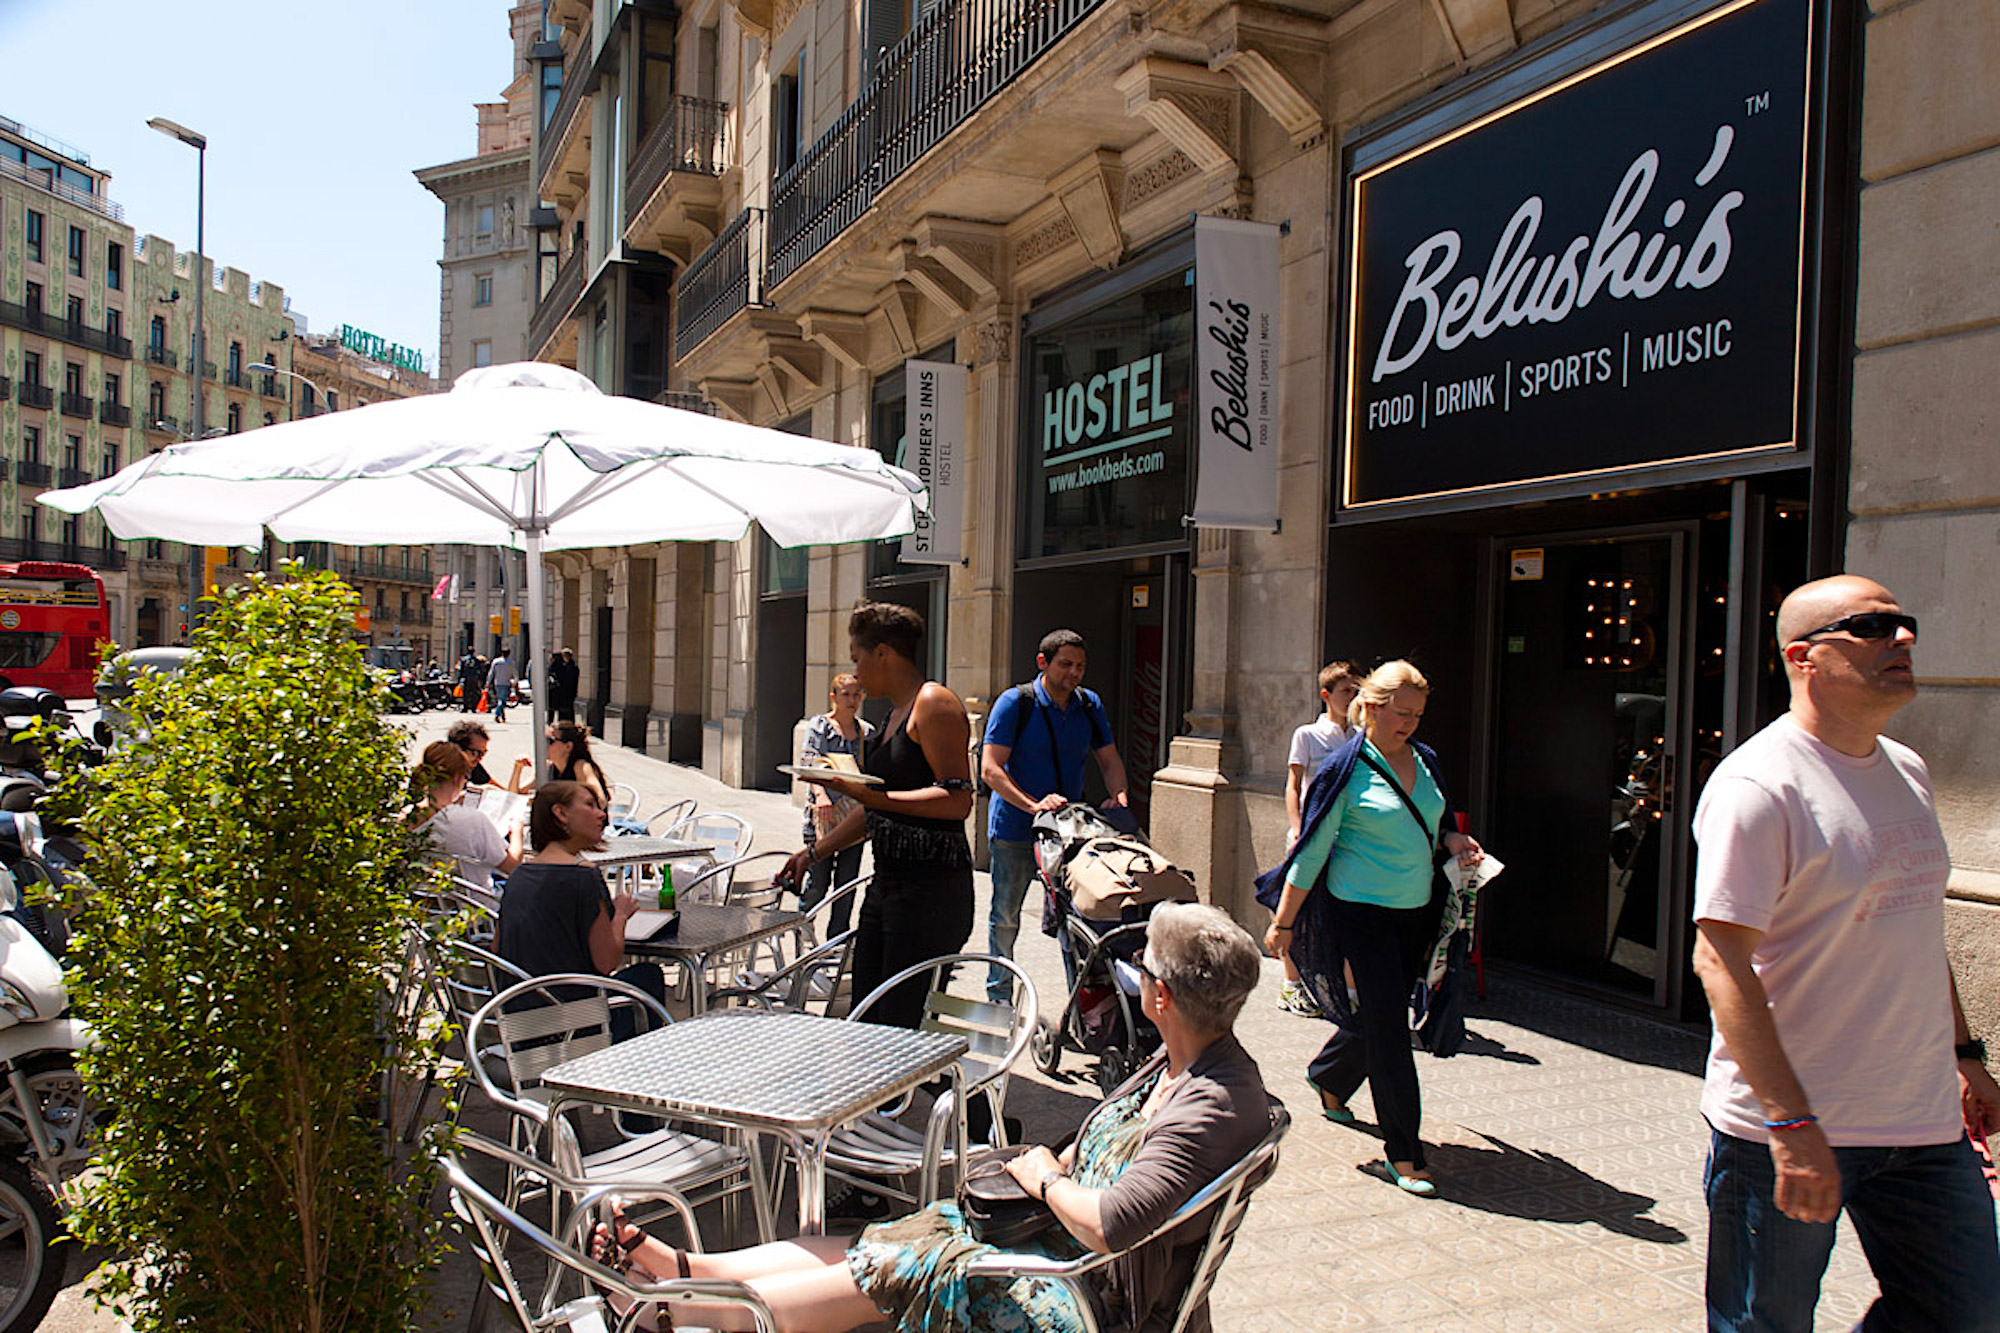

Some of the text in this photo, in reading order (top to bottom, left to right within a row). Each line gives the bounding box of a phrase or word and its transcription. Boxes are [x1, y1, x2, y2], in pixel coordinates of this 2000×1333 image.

[1371, 124, 1745, 384] Belushi's
[342, 323, 387, 363] HOTEL
[1209, 298, 1253, 453] Belushi's
[1260, 313, 1270, 446] FOOD DRINK SPORTS MUSIC
[1368, 318, 1733, 430] FOOD DRINK SPORTS MUSIC
[920, 370, 934, 408] INNS
[1043, 352, 1174, 453] HOSTEL
[940, 441, 952, 486] HOSTEL
[1048, 451, 1164, 494] www.bookbeds.com
[916, 536, 929, 552] ST
